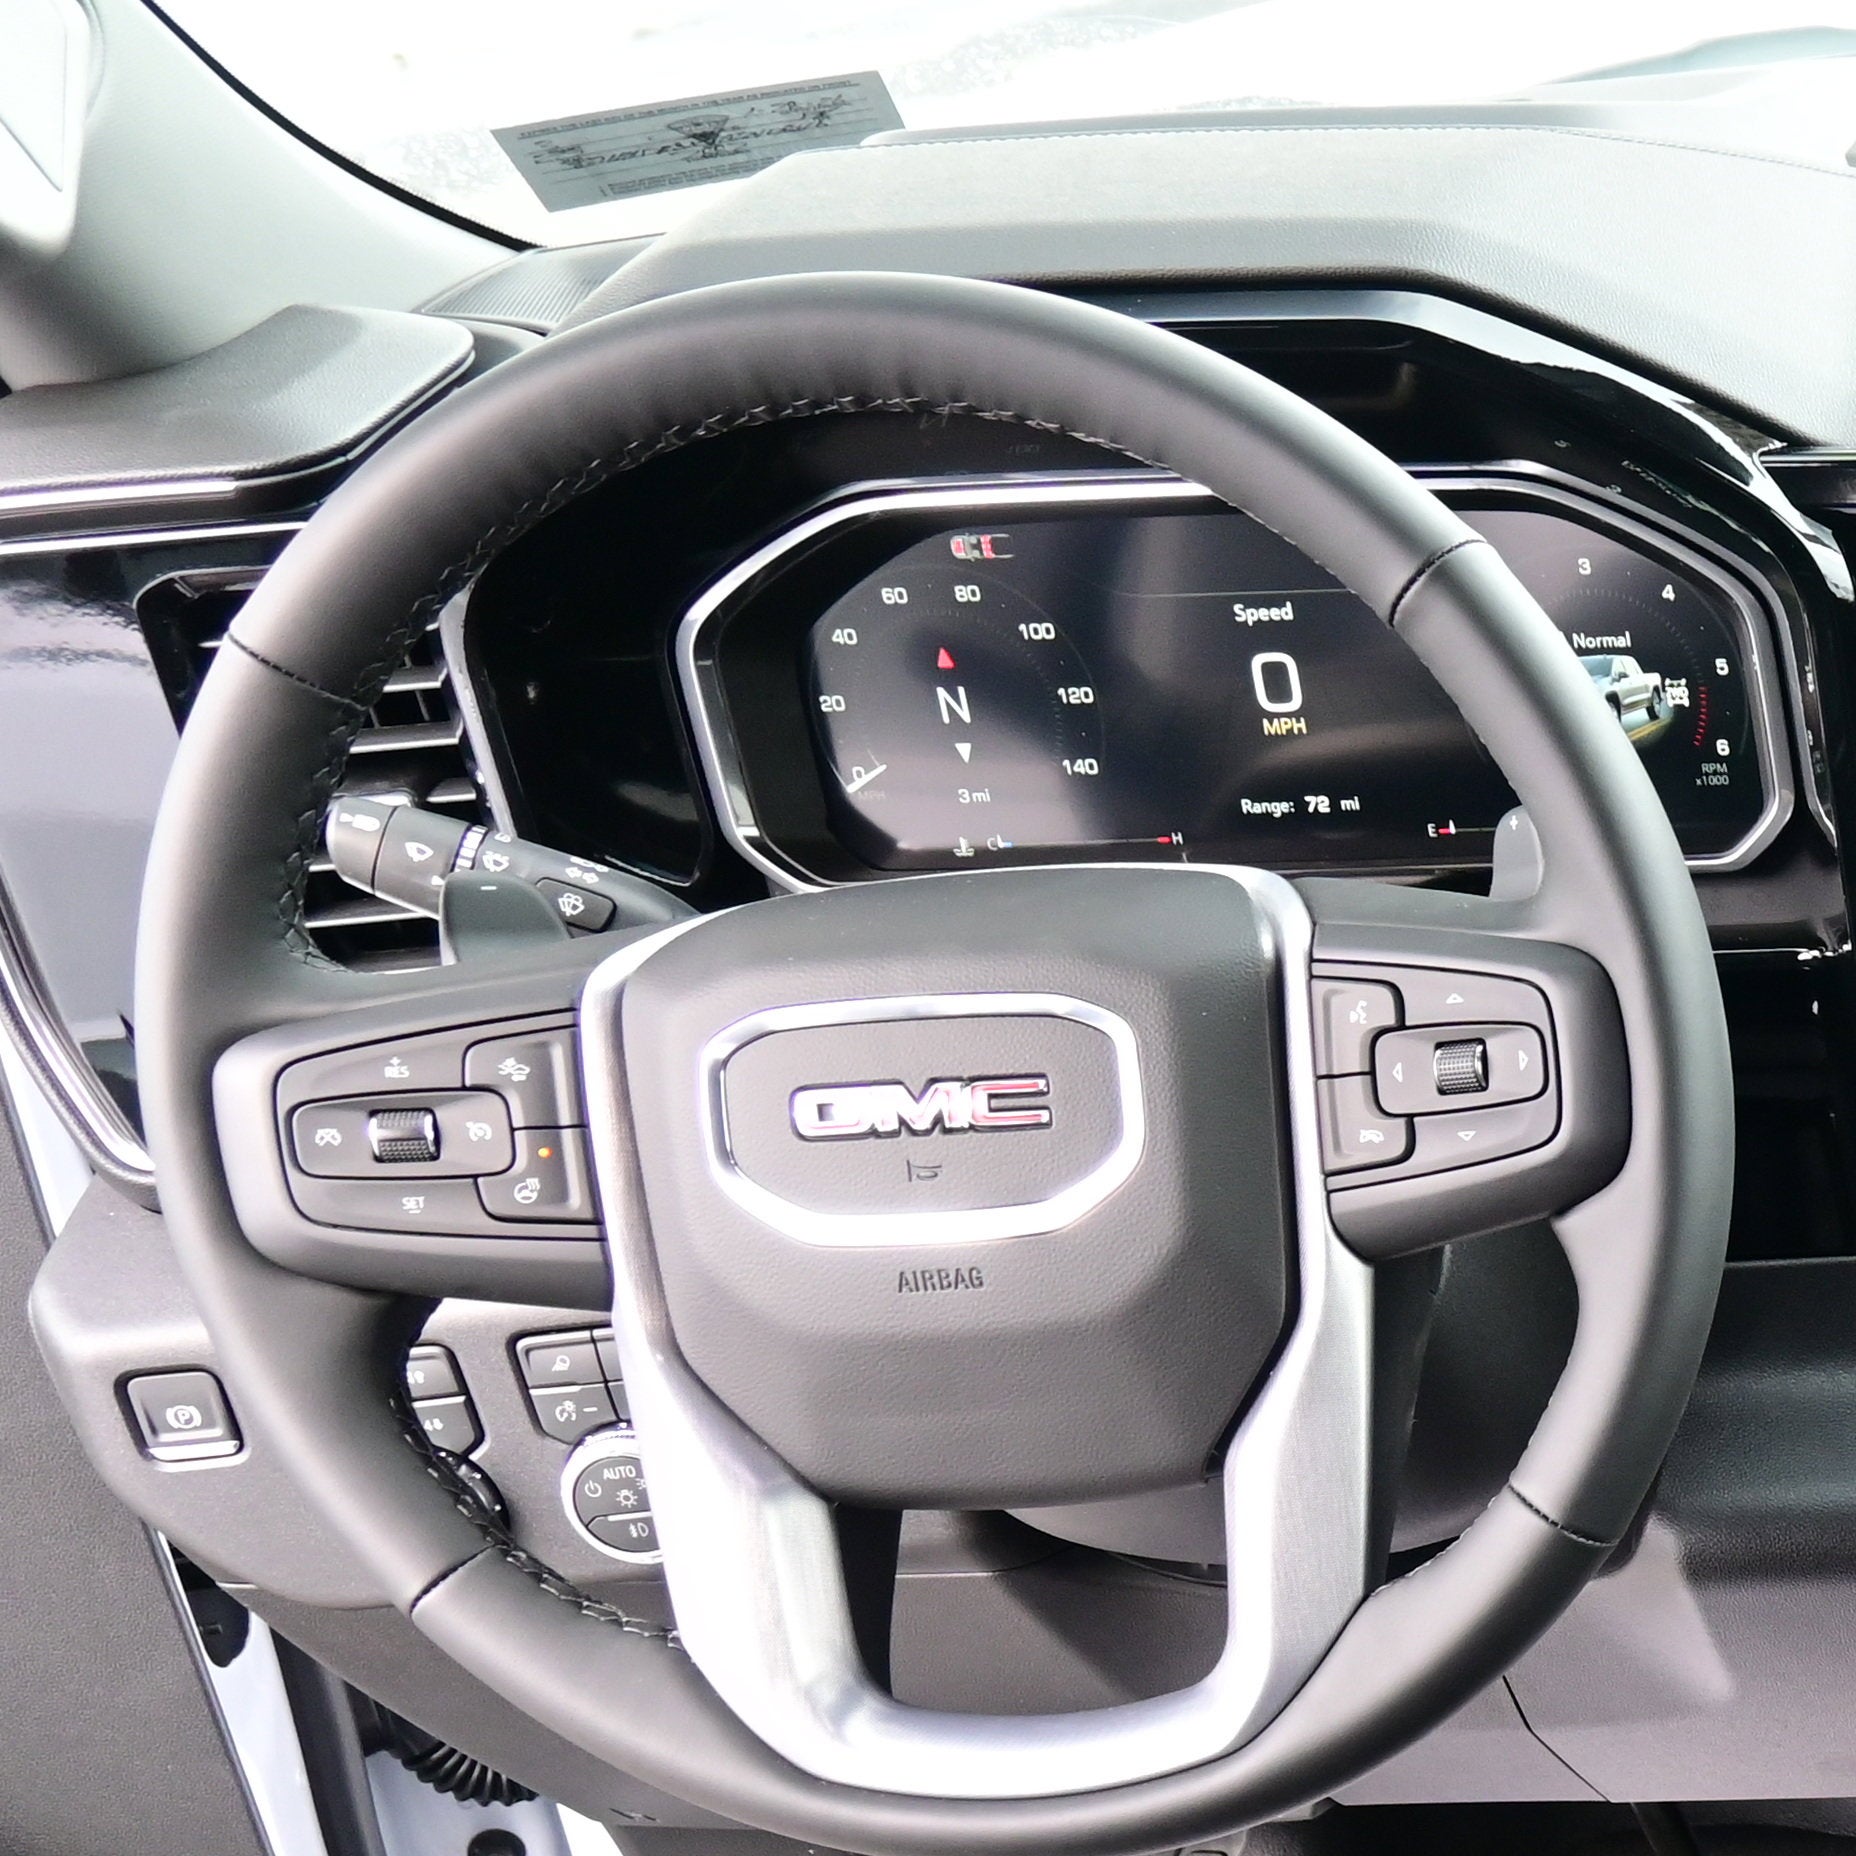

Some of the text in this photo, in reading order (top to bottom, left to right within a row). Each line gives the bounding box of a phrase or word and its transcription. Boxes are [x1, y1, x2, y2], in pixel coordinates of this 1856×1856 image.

[1578, 558, 1591, 575] 3
[881, 587, 908, 605] 60
[954, 585, 981, 602] 80
[1661, 584, 1676, 602] 4
[1233, 601, 1294, 626] Speed
[832, 628, 857, 645] 40
[1019, 622, 1055, 640] 100
[1572, 631, 1631, 649] Normal
[1715, 658, 1729, 676] 5
[1251, 651, 1303, 713] 0
[819, 695, 845, 712] 20
[1057, 687, 1094, 704] 120
[936, 685, 972, 724] N
[1262, 717, 1308, 736] MPH
[1715, 739, 1730, 756] 6
[1063, 758, 1098, 776] 140
[1701, 762, 1728, 774] RPM
[1696, 775, 1729, 786] x1000
[958, 788, 991, 803] 3 mi
[1240, 795, 1360, 818] Range: 72 mi
[1171, 832, 1184, 845] H
[1427, 823, 1438, 837] E
[986, 837, 998, 850] C
[384, 1065, 410, 1078] RES
[790, 1072, 1052, 1141] GMC
[402, 1195, 425, 1210] SET
[897, 1266, 985, 1294] AIRBAG
[603, 1465, 636, 1481] AUTO
